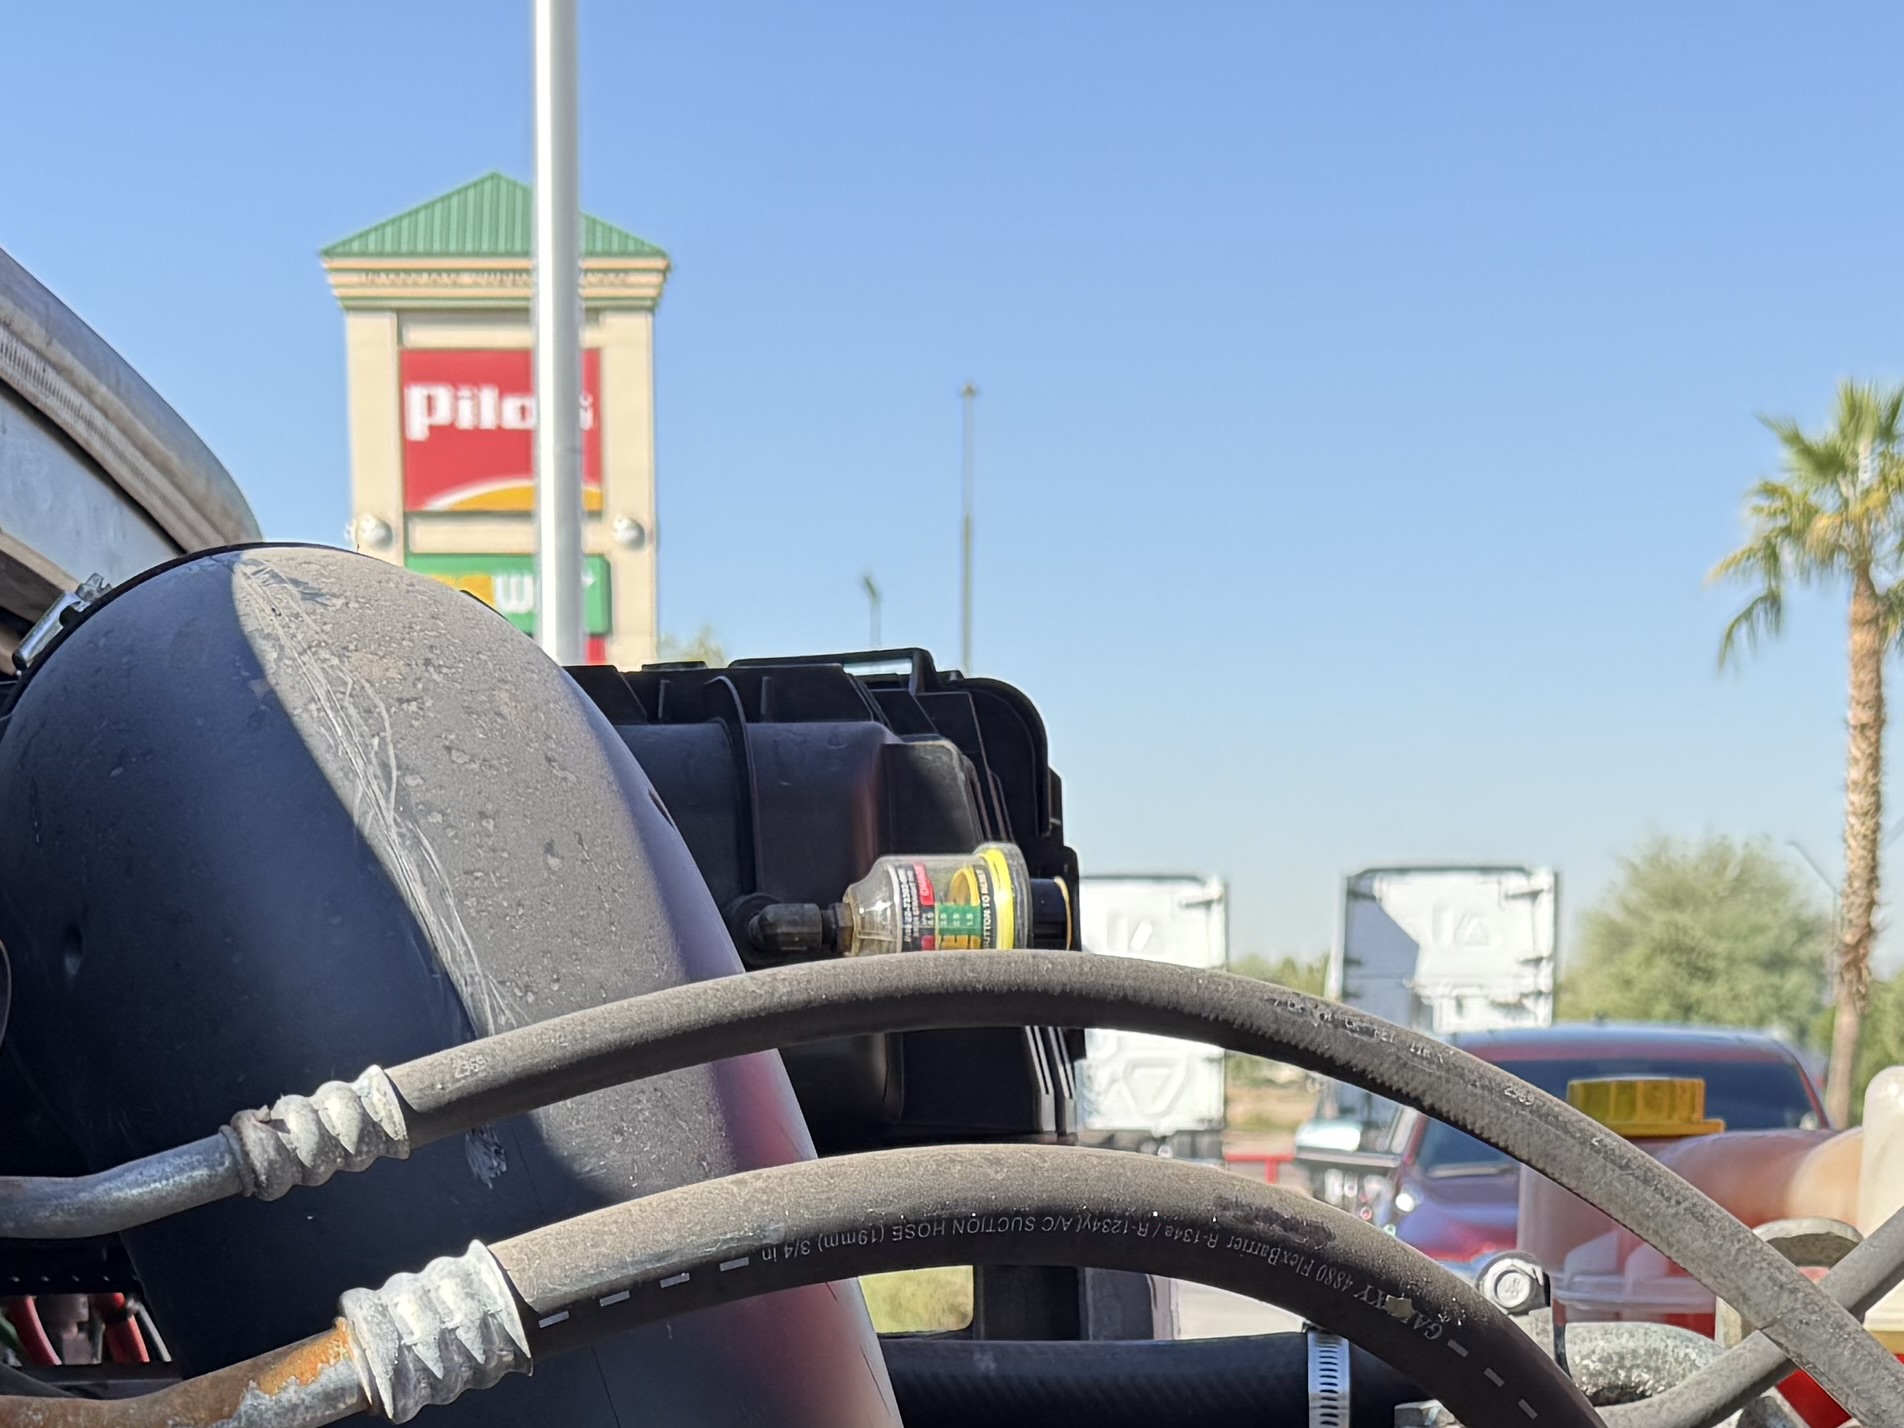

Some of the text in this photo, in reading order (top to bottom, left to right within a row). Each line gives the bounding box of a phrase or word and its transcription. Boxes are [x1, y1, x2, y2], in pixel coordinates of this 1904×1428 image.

[891, 1220, 946, 1242] HOSE
[952, 1215, 1036, 1236] SUCTION
[1042, 1215, 1073, 1233] A/C
[1076, 1216, 1149, 1238] R-1234yf
[783, 1239, 812, 1260] 3/4
[817, 1225, 885, 1252] (19mm)
[762, 1246, 777, 1262] in
[1225, 1233, 1315, 1279] FlexBarrier
[1316, 1262, 1353, 1293] 4880
[1353, 1281, 1442, 1341] GAXY
